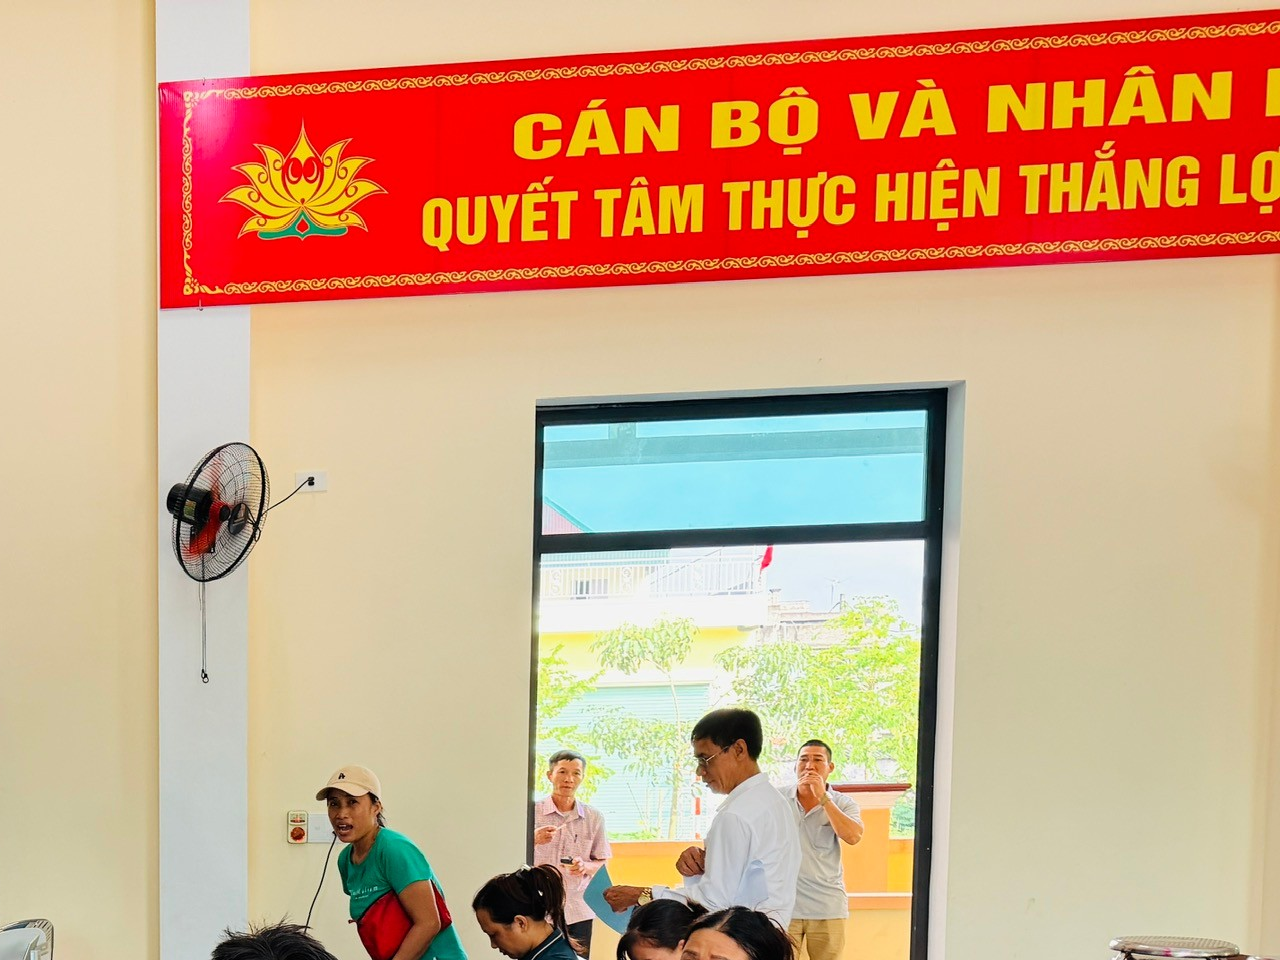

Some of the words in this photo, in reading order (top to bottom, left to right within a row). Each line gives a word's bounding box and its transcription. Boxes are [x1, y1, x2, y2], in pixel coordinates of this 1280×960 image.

[513, 98, 680, 160] CÁN
[710, 86, 819, 156] BỘ
[848, 78, 957, 141] VÀ
[986, 65, 1233, 133] NHÂN
[422, 176, 579, 252] QUYẾT
[594, 176, 704, 237] TÂM
[722, 171, 856, 239] THỰC
[874, 158, 1001, 232] HIỆN
[1018, 140, 1200, 216] THẮNG
